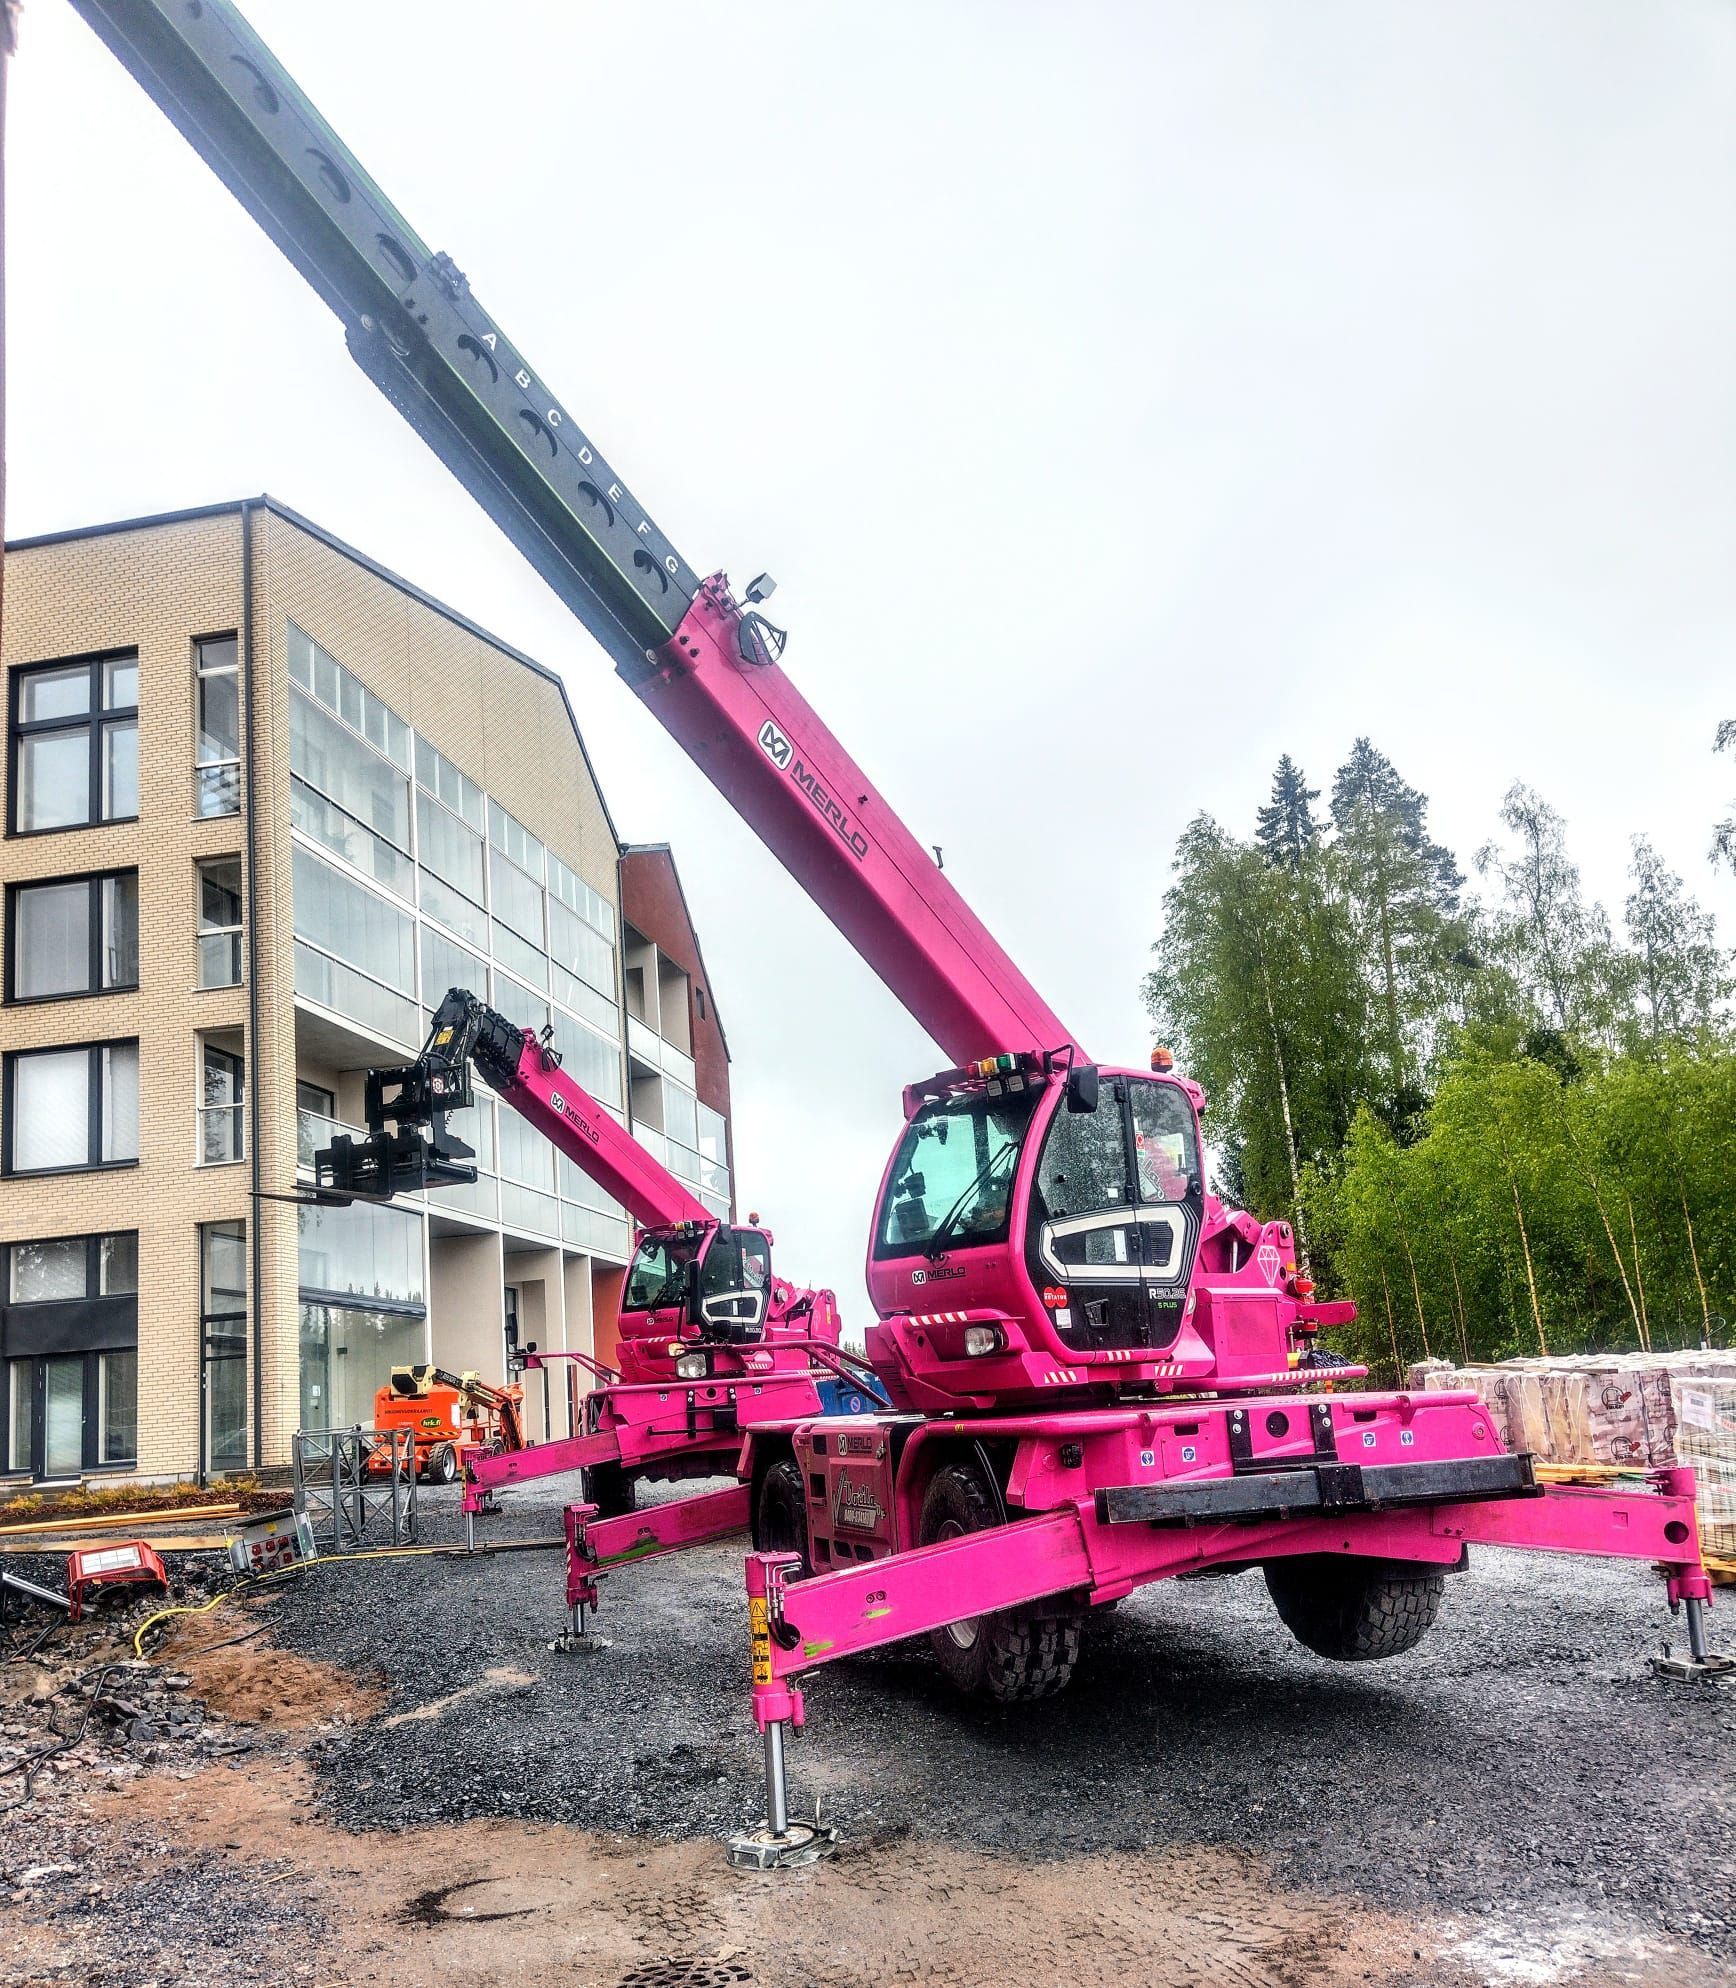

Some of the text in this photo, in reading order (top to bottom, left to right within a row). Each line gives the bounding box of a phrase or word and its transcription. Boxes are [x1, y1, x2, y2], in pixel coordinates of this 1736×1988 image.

[481, 333, 679, 574] A B C D E F G
[791, 760, 868, 860] MERLO
[565, 1105, 600, 1143] MERLO
[927, 1266, 966, 1279] MERLO
[1163, 1301, 1178, 1309] PLUS
